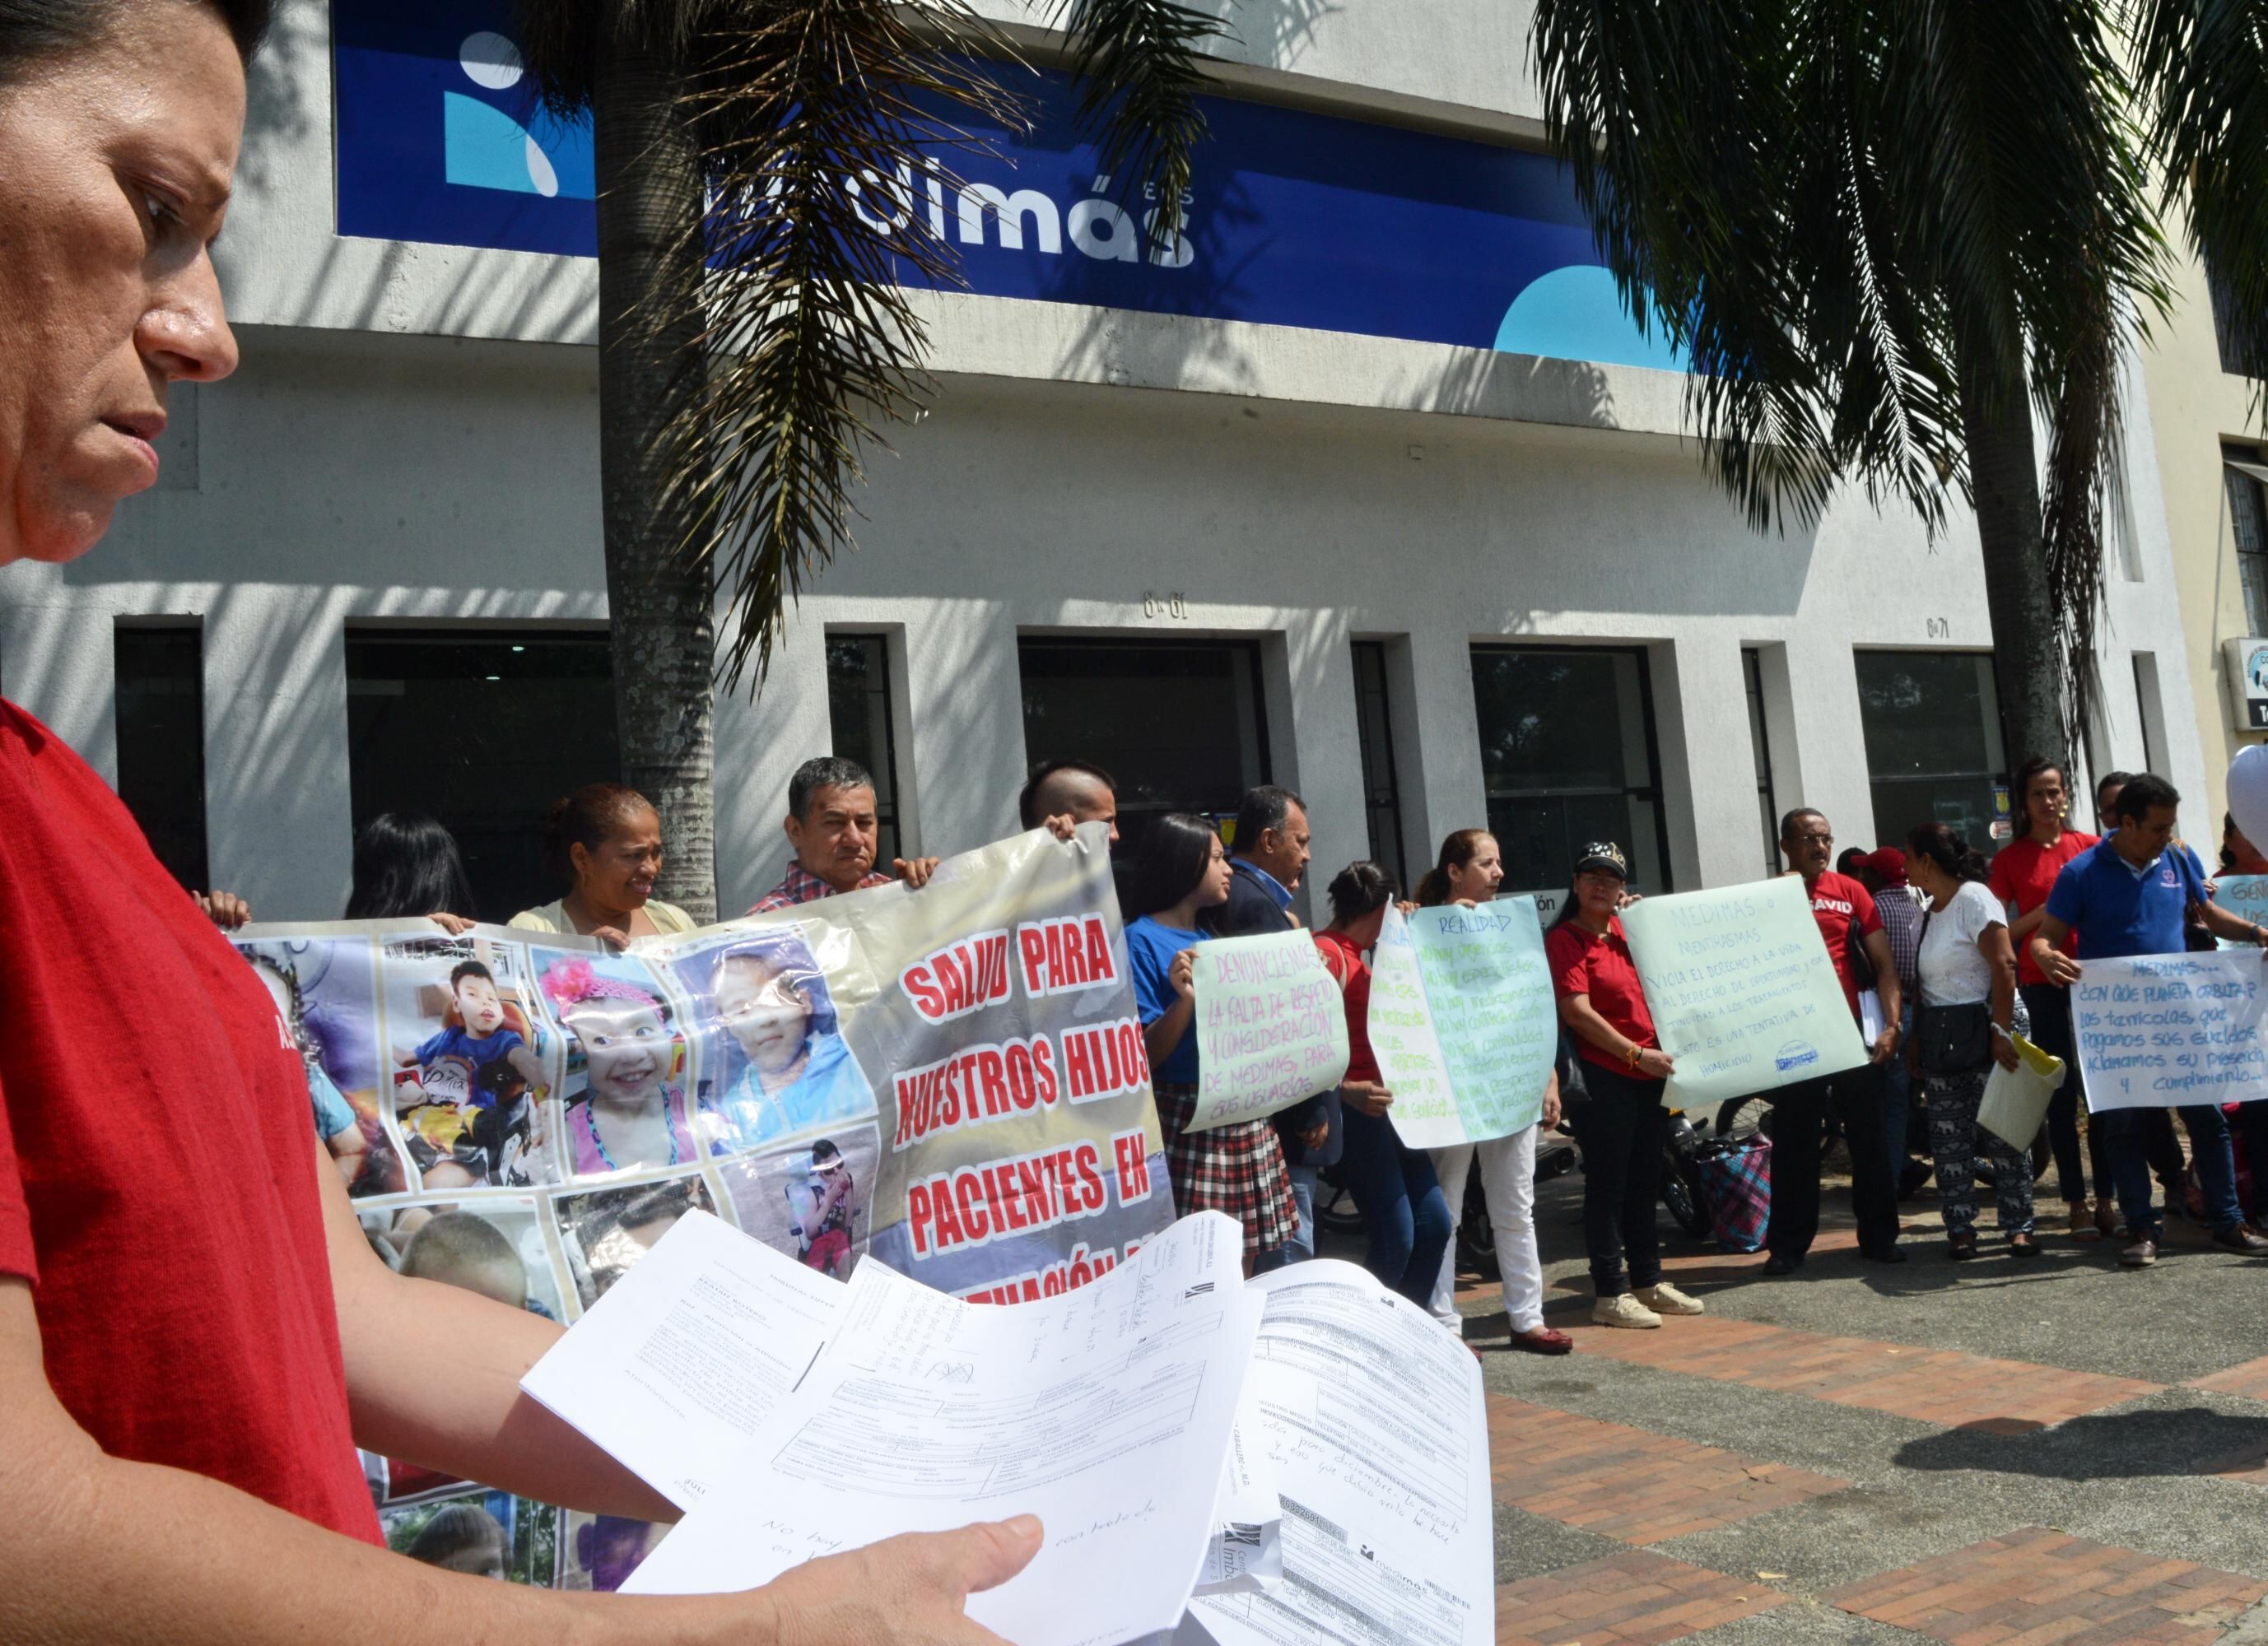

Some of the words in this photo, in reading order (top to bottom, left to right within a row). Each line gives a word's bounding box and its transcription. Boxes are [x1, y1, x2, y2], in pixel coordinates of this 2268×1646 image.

[1439, 915, 1511, 936] REALIDAD
[1670, 898, 1756, 928] MEDIMAS
[904, 934, 1008, 1018] SALUD
[1020, 918, 1114, 990] PARA
[1646, 970, 1687, 989] VIOLA
[1690, 967, 1706, 982] EL
[1707, 957, 1750, 979] DERECHO
[1753, 954, 1761, 965] A
[1763, 949, 1776, 961] LA
[1778, 942, 1803, 957] VIDA
[1662, 996, 1678, 1010] AL
[1679, 983, 1726, 1007] DERECHO
[1730, 979, 1746, 993] DE
[1749, 964, 1801, 988] OPORTUNIDAD
[1803, 960, 1809, 974] Y
[1209, 999, 1222, 1027] LA
[1227, 994, 1265, 1024] FALTA
[1269, 993, 1284, 1019] DE
[1728, 1001, 1744, 1014] LOS
[1745, 979, 1808, 1007] TRATAMIENTOS
[2144, 981, 2192, 1003] PLANETA
[1674, 1041, 1701, 1058] ESTO
[1727, 1028, 1745, 1043] UNA
[1745, 1009, 1799, 1035] TENTATIVA
[1802, 1004, 1817, 1016] DE
[896, 1039, 1056, 1146] NUESTROS
[1064, 1021, 1148, 1099] HIJOS
[1204, 1072, 1222, 1093] DE
[1304, 1041, 1336, 1068] PARA
[1698, 1053, 1753, 1078] HOMICIDIO
[1245, 1076, 1313, 1110] USUARIOS
[910, 1144, 1104, 1253] PACIENTES
[1115, 1133, 1149, 1205] EN
